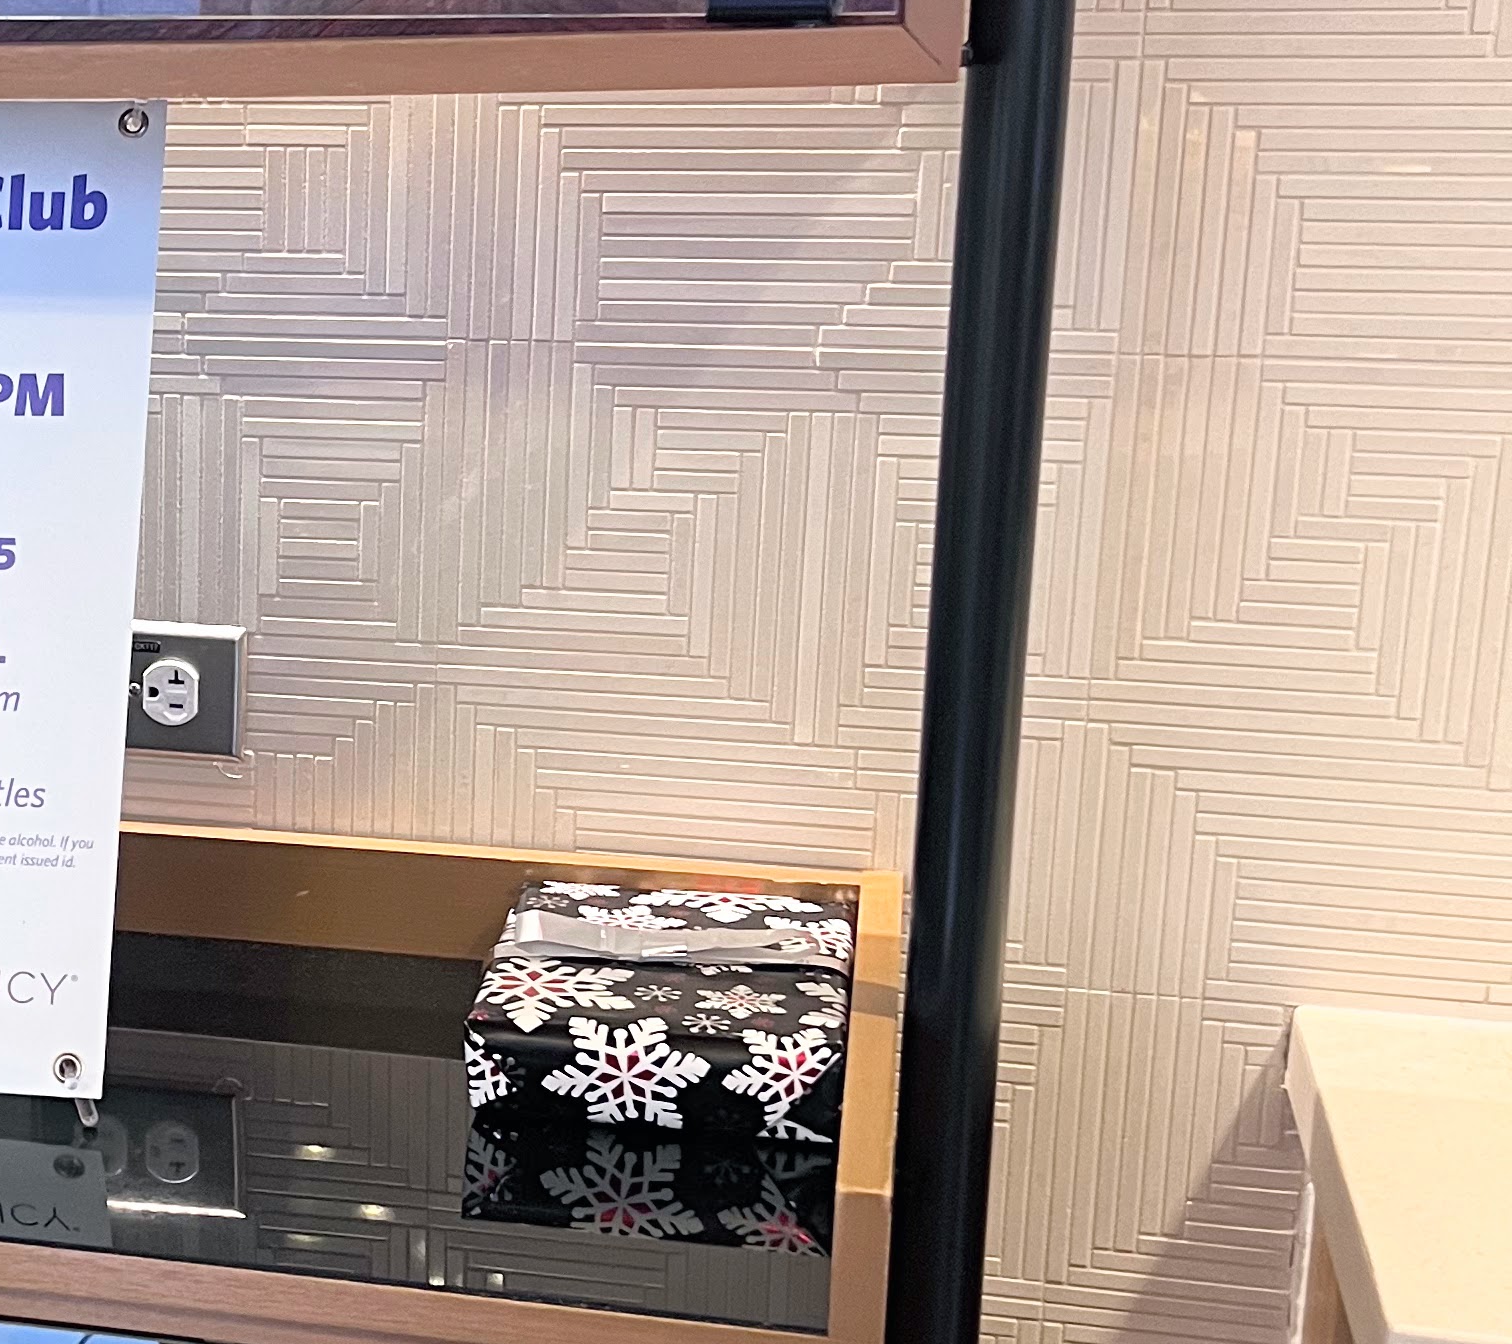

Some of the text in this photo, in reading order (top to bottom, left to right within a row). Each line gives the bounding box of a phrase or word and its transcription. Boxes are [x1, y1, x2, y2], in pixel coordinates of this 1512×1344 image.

[8, 833, 57, 849] alcohol.
[59, 836, 70, 852] If
[71, 839, 94, 852] you
[20, 854, 59, 868] issued
[61, 855, 76, 869] id.
